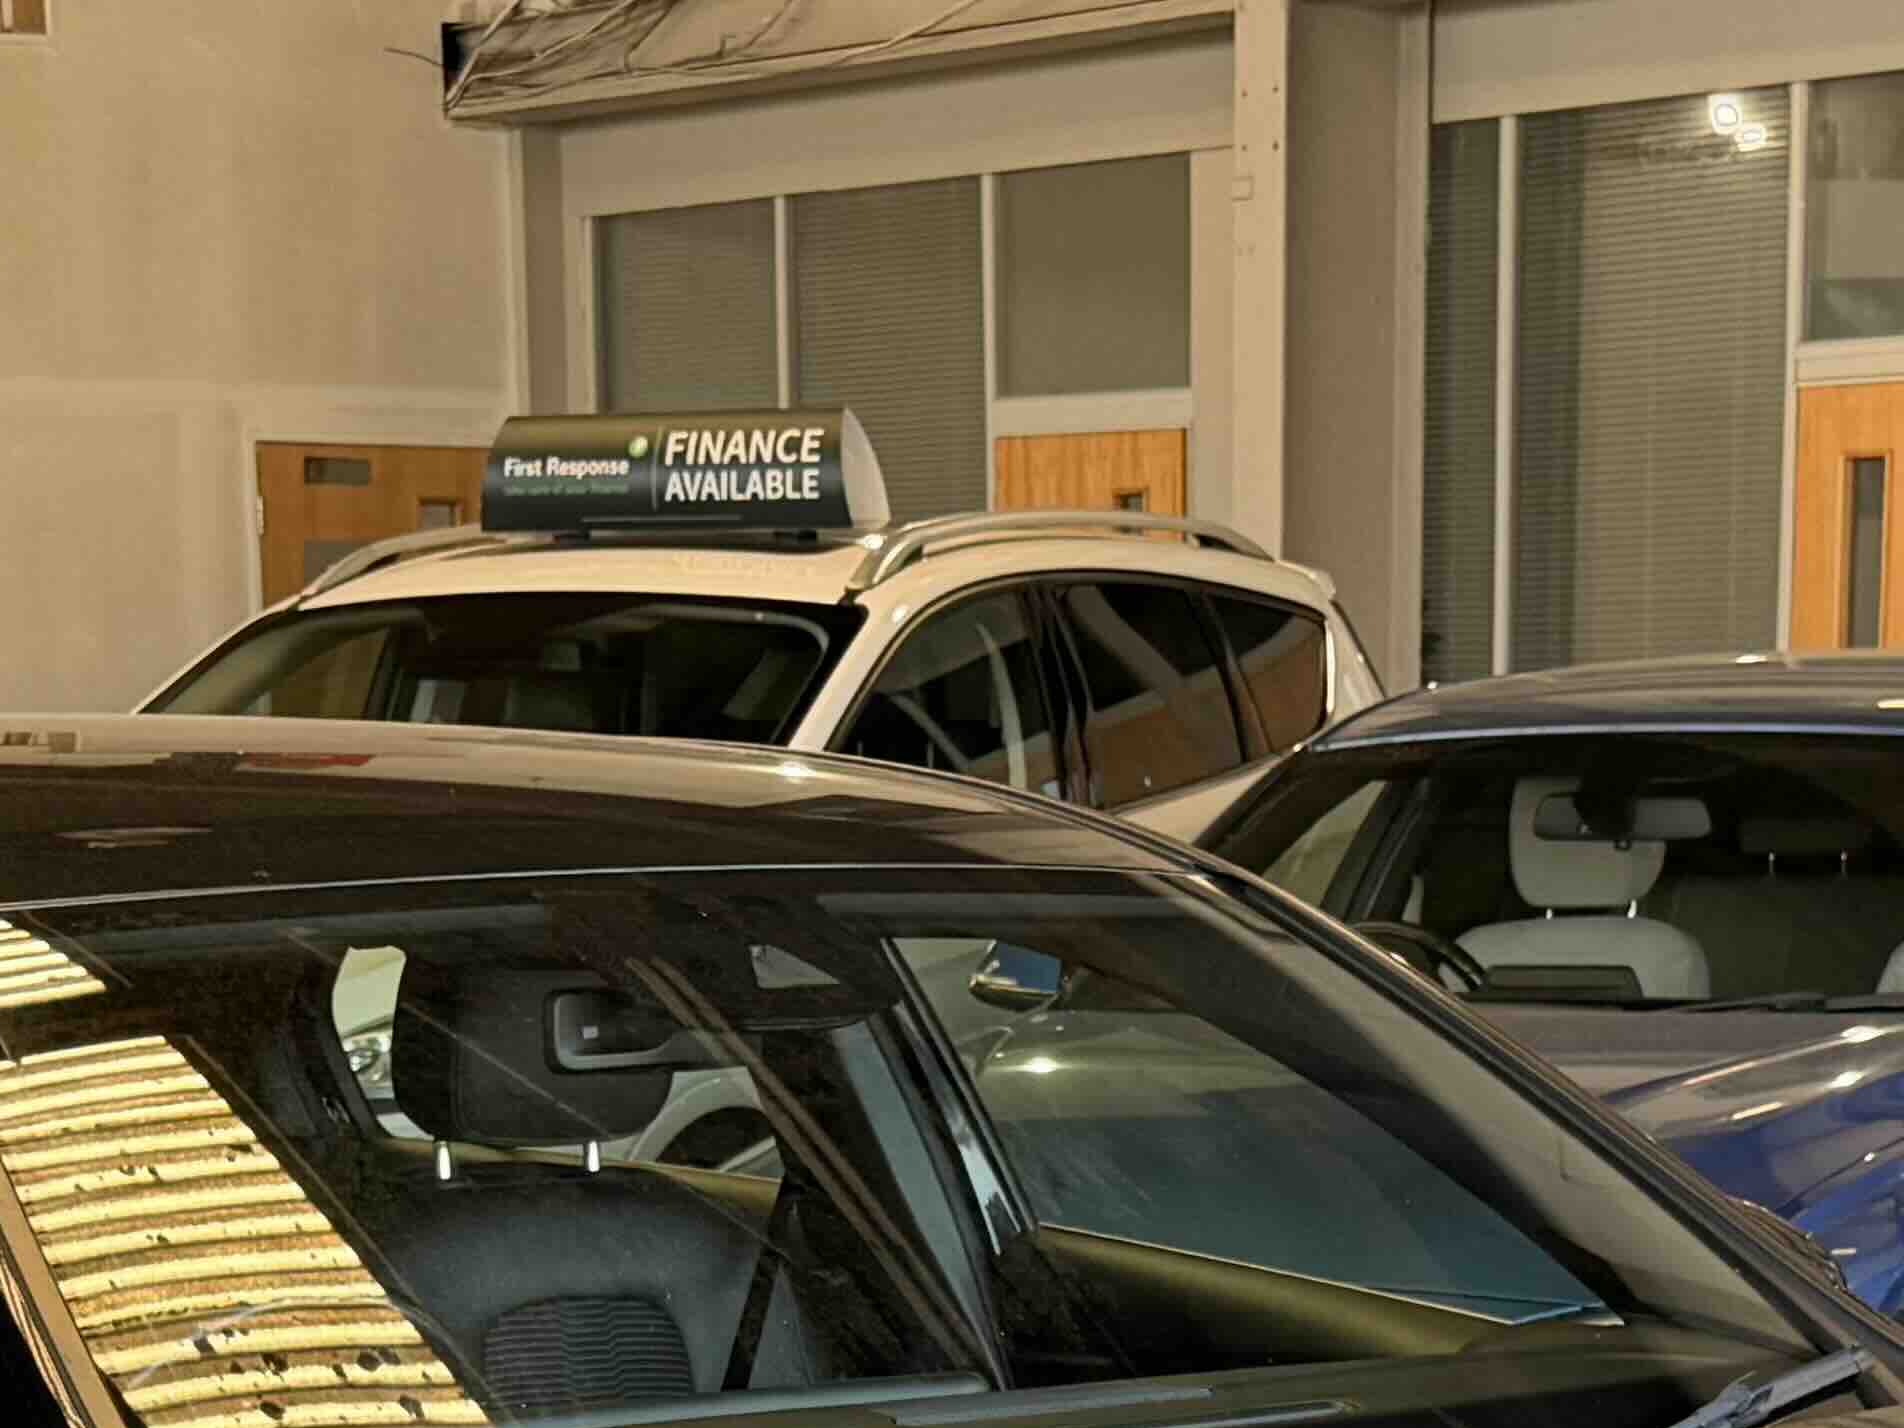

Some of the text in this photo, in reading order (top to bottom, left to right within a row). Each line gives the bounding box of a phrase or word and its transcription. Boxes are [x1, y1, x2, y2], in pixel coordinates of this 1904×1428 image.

[664, 428, 825, 466] FINANCE
[503, 455, 630, 480] First Response
[664, 468, 820, 502] AVAILABLE
